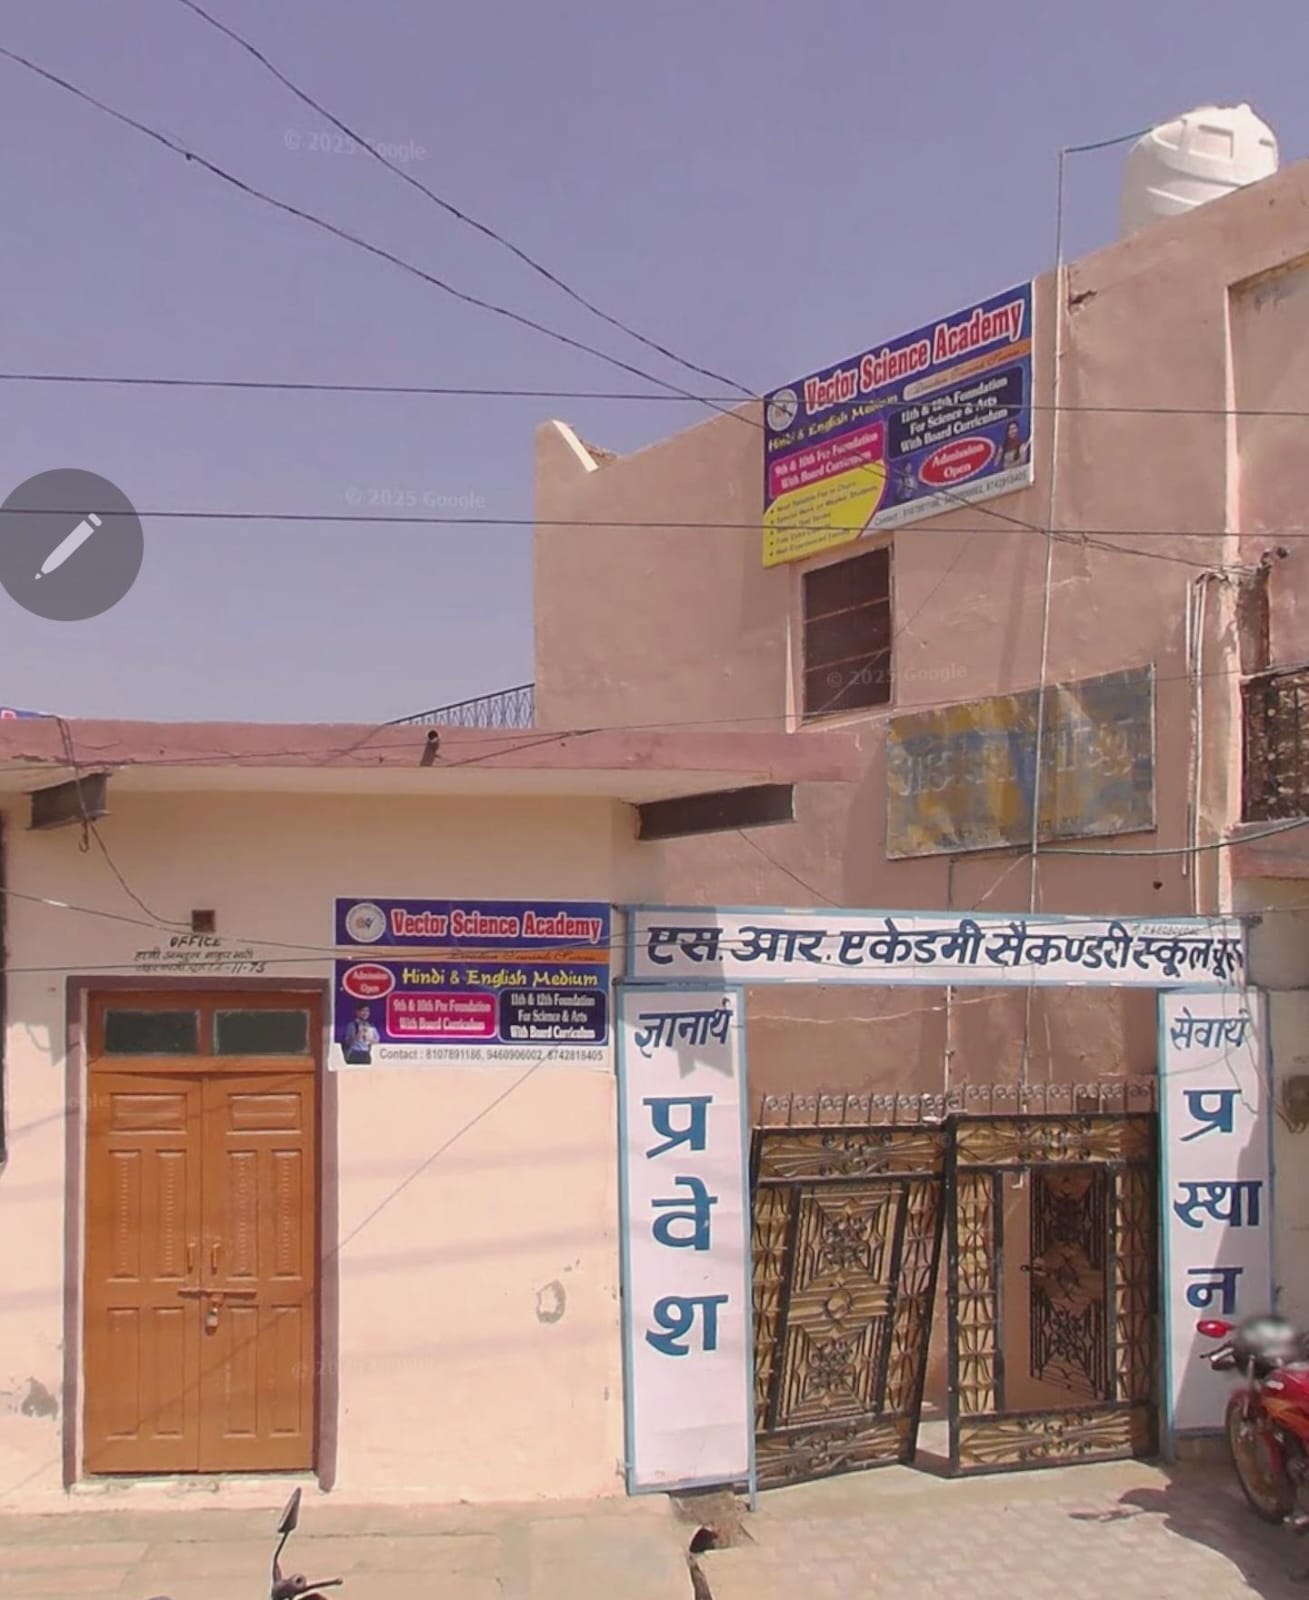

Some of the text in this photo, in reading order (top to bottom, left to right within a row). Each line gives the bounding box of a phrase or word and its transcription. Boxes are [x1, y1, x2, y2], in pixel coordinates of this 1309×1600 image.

[804, 370, 858, 414] Vector
[860, 338, 930, 392] Science
[933, 299, 1025, 363] Academy
[901, 408, 920, 424] 11th
[921, 405, 930, 416] &
[953, 377, 1008, 403] Foundation
[808, 412, 848, 436] English
[851, 395, 898, 420] Medium
[910, 396, 998, 435] For Science & Arts
[900, 408, 1008, 453] With Board Curriculum
[832, 432, 879, 454] Foundation
[932, 443, 985, 468] Admission
[780, 474, 800, 490] With
[800, 463, 825, 482] Board
[943, 462, 972, 479] Open
[391, 908, 603, 944] Vector Science Academy
[729, 926, 831, 964] आर.
[1133, 936, 1215, 978] स्कूल
[359, 983, 380, 995] Open
[402, 968, 599, 988] Hindi & English Medium
[393, 999, 407, 1012] 9th
[408, 999, 416, 1012] &
[449, 999, 492, 1013] Foundation
[511, 993, 596, 1006] 11th & 12th Foundation
[399, 1017, 486, 1031] With Board Curriculum
[518, 1009, 588, 1023] For Science & Arts
[510, 1025, 596, 1039] With Board Curriculum
[379, 1047, 418, 1060] Contact
